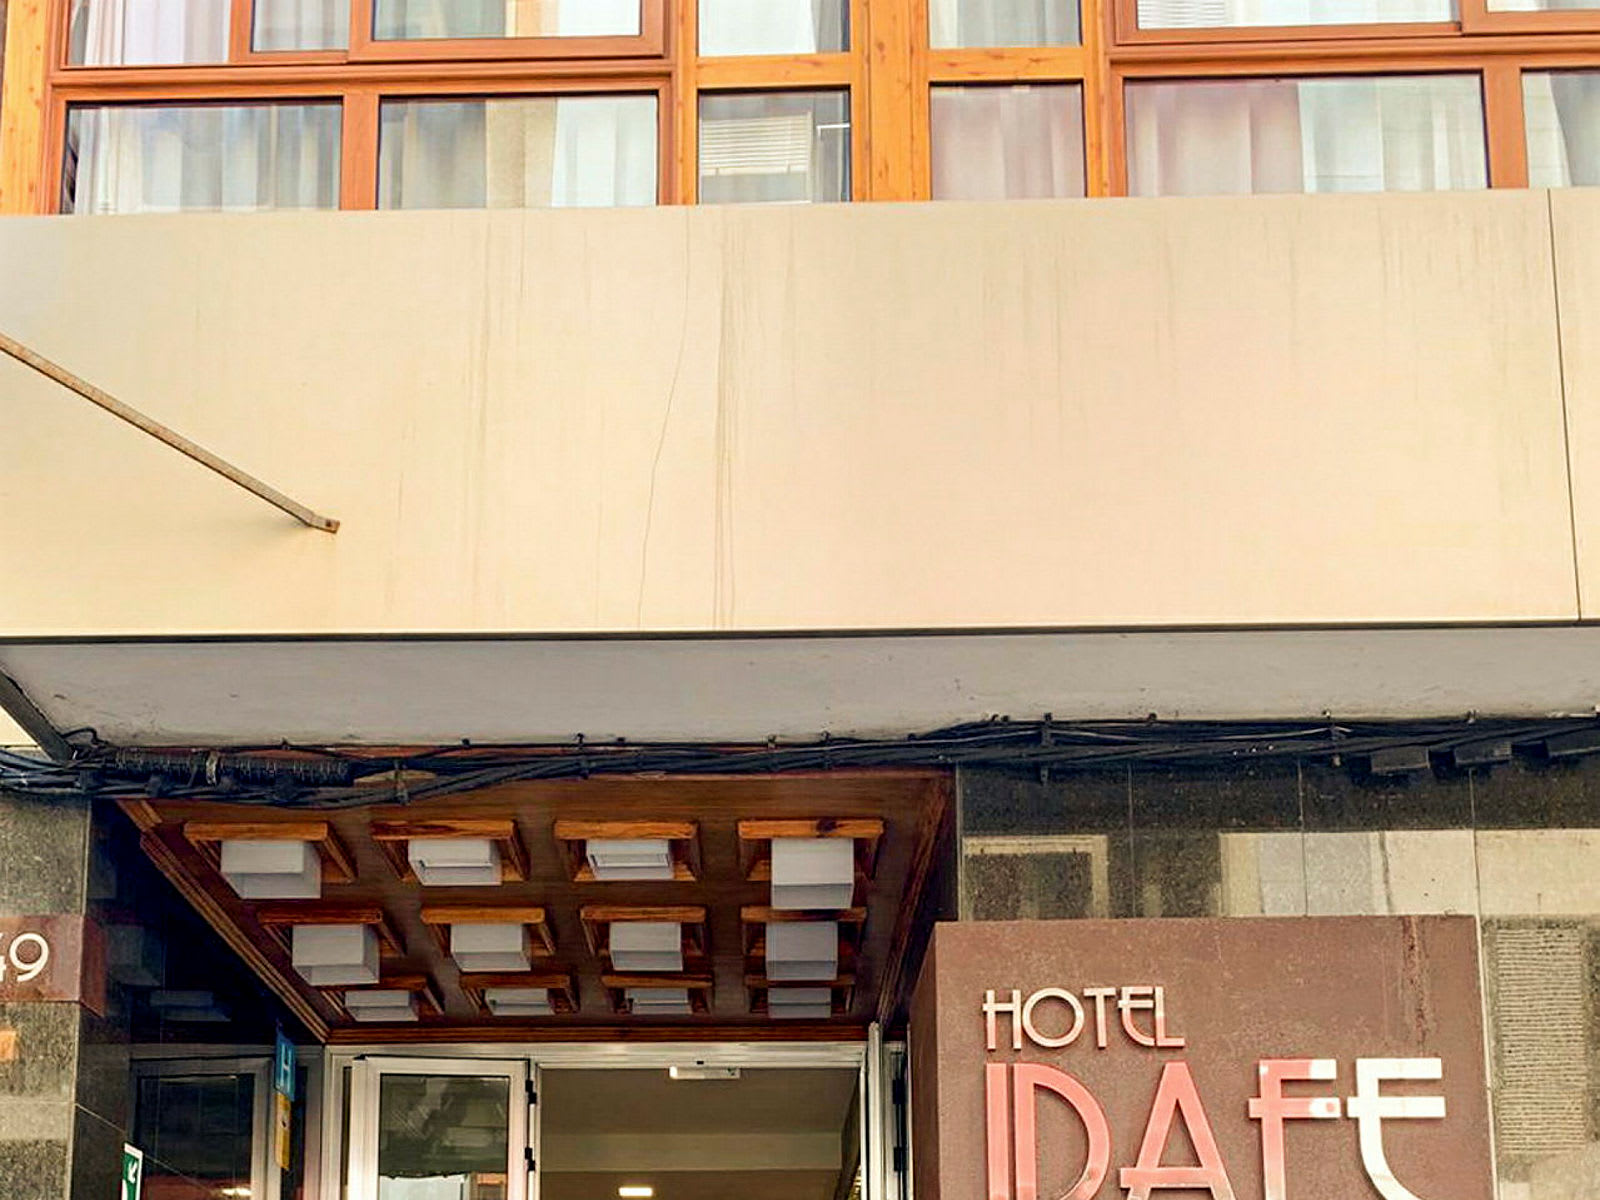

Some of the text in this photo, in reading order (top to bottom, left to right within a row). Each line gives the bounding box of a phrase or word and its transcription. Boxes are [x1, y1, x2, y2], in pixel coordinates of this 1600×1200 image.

[0, 932, 49, 982] 9
[982, 986, 1186, 1051] HOTEL
[279, 1043, 292, 1093] H
